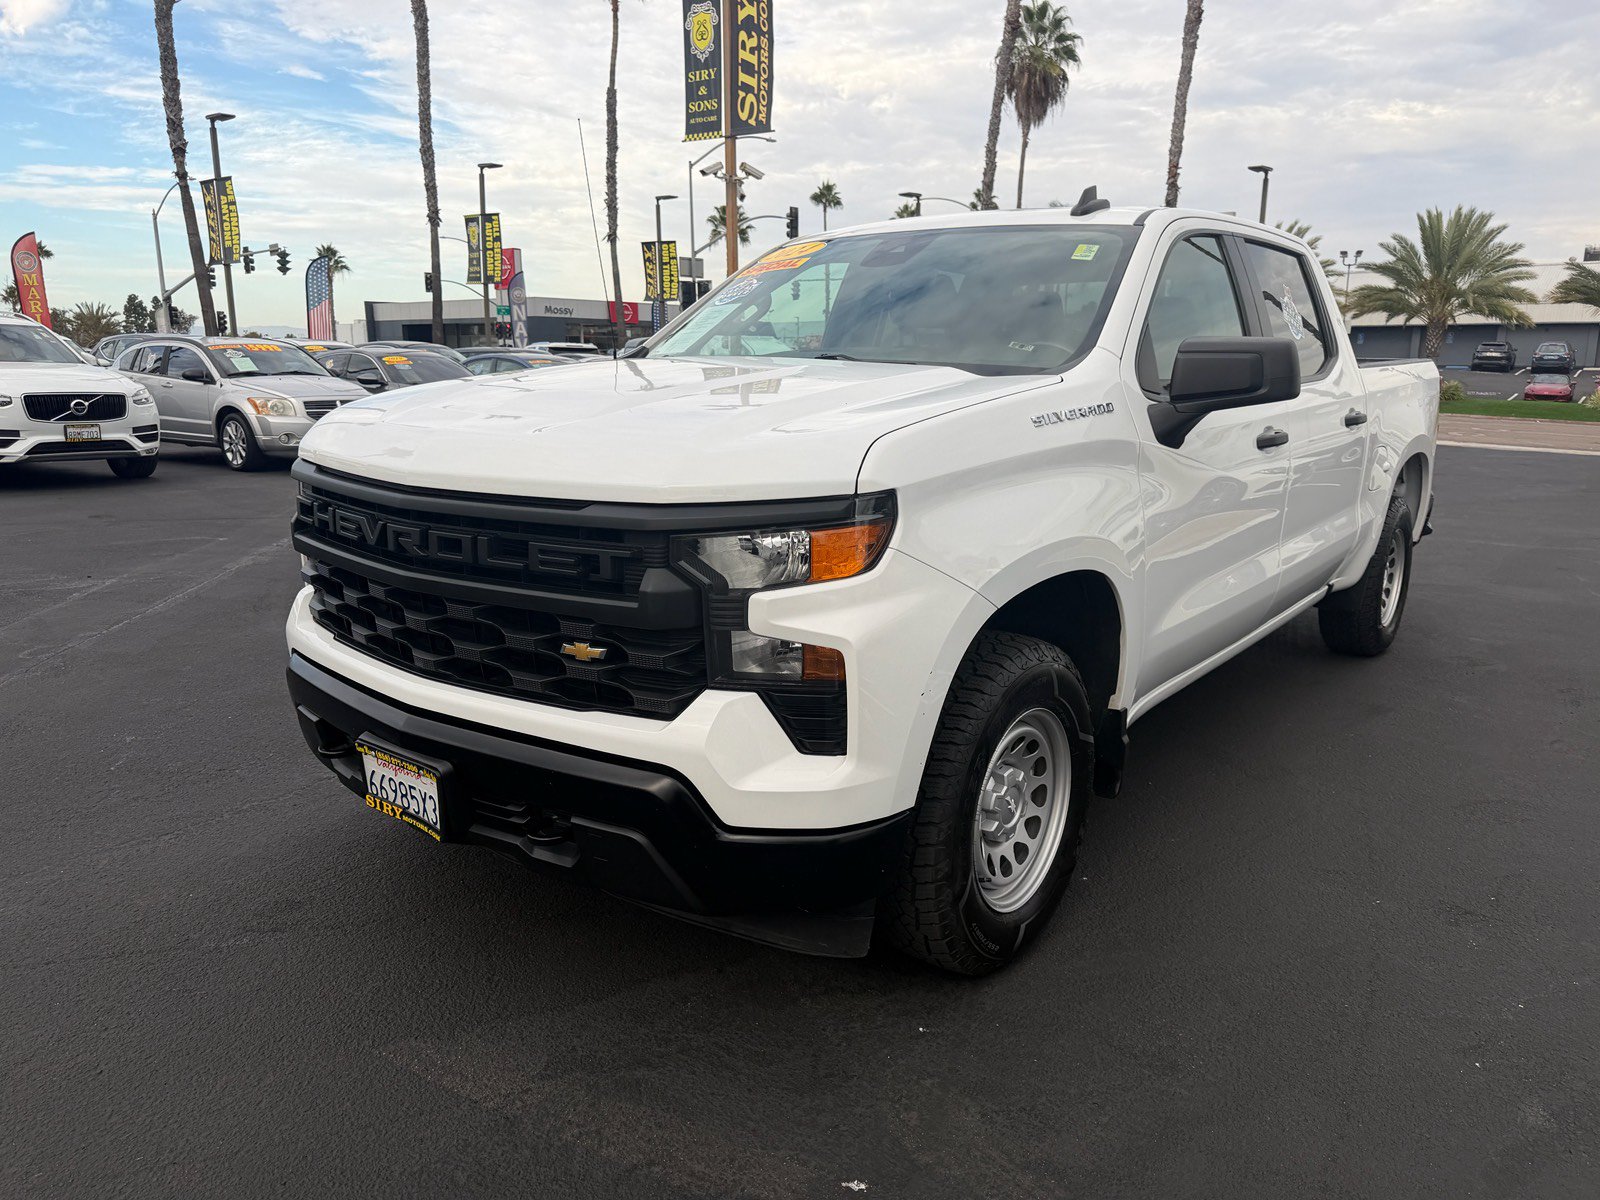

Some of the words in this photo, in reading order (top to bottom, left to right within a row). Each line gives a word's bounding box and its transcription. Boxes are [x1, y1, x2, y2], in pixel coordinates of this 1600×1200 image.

[687, 67, 717, 83] SIRY
[737, 0, 758, 126] SIRY
[759, 0, 769, 125] MOTORS.CO
[697, 85, 708, 96] &
[688, 98, 718, 113] SONS
[225, 180, 235, 203] WE
[220, 195, 232, 248] ANYONE
[229, 205, 240, 262] FINANCE
[485, 221, 493, 249] AUTO
[491, 215, 500, 238] FULL
[486, 250, 494, 276] CARE
[493, 241, 502, 282] SERVICE
[661, 243, 670, 263] OUR
[669, 243, 677, 258] WE
[662, 263, 671, 299] TROOPS
[670, 258, 679, 299] SUPPORT
[544, 305, 574, 317] Mossy
[1029, 402, 1115, 428] SILVERADO
[296, 495, 643, 581] CHEVROLET
[369, 770, 438, 826] 66985X3
[365, 794, 403, 820] SIRY
[402, 815, 441, 842] MOTORS.COM
